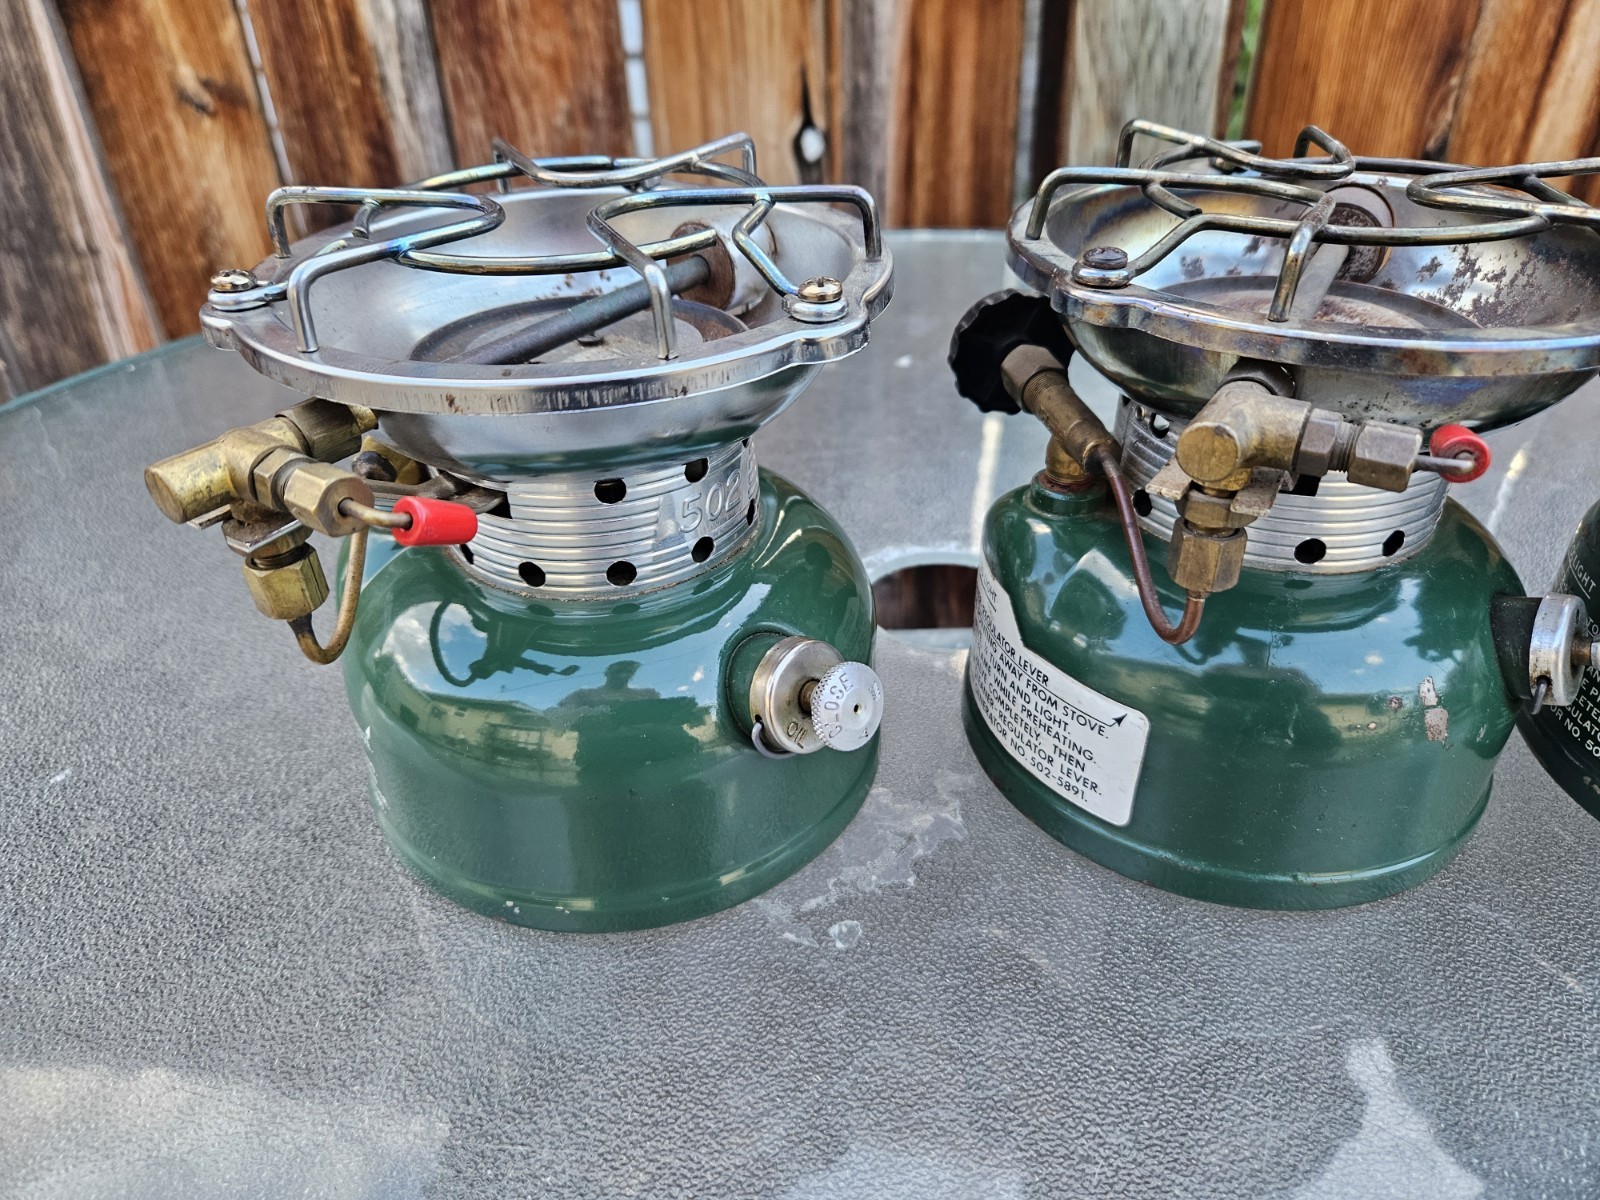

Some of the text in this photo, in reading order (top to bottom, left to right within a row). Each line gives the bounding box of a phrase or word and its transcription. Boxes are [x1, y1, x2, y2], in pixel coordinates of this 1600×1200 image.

[679, 469, 740, 533] 502
[1572, 555, 1597, 592] LIGHT
[989, 653, 1007, 682] TURN
[1009, 681, 1031, 705] AND
[1034, 701, 1071, 735] LIGHT.
[998, 651, 1024, 681] AWAY
[1026, 678, 1058, 711] FROM
[1062, 705, 1109, 739] STOVE.
[1019, 655, 1049, 687] LEVER
[1586, 666, 1600, 683] AN
[786, 721, 807, 749] OIL
[988, 682, 1041, 746] COMPLETELY,
[1052, 743, 1085, 773] THEN
[994, 674, 1016, 707] WHILE
[1021, 704, 1097, 764] PREHEATING.
[1059, 763, 1102, 796] LEVER.
